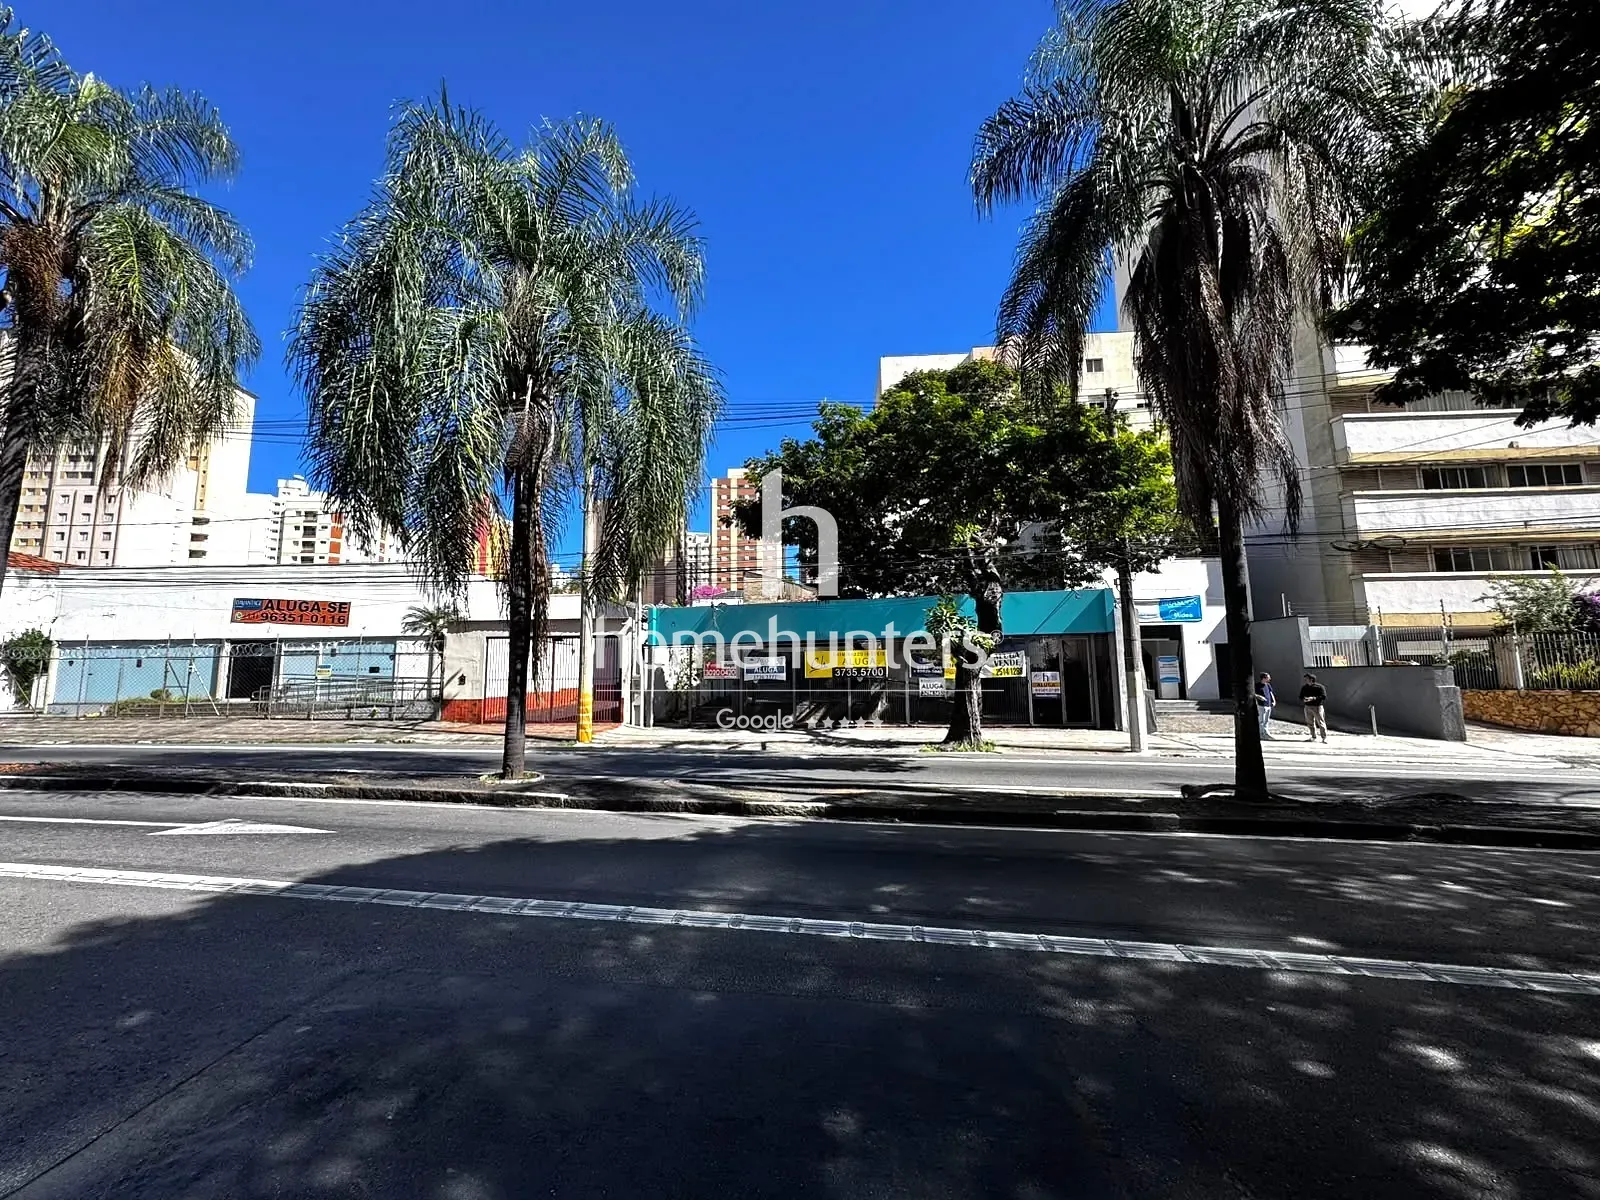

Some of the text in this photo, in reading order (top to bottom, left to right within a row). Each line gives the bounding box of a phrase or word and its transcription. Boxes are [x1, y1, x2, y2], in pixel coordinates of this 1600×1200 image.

[263, 599, 348, 613] ALUGA-SE
[260, 612, 346, 624] 96351-0116
[842, 657, 877, 666] ALUGA
[993, 659, 1021, 667] VENDE
[754, 666, 779, 674] ALUGA
[834, 667, 884, 677] 3735.5700
